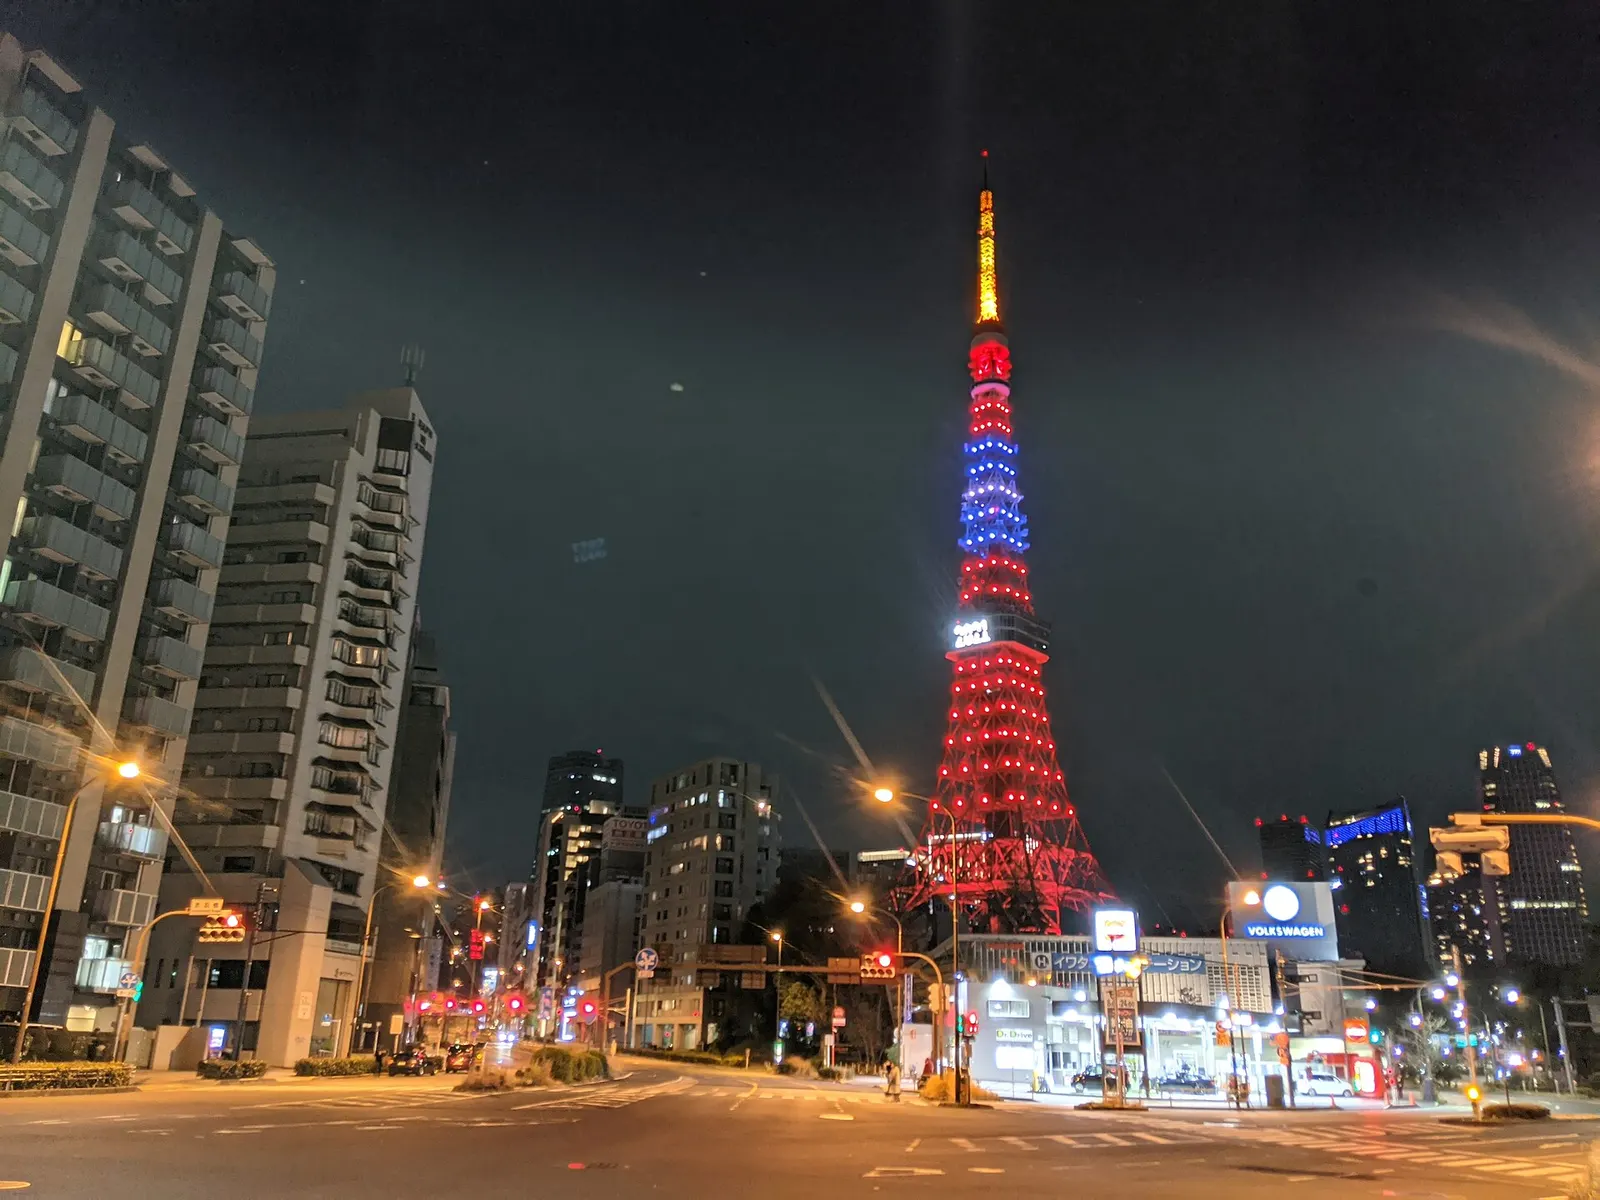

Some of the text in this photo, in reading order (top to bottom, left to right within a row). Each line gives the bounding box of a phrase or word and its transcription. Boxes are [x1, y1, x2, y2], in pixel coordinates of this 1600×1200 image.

[1247, 926, 1324, 937] VOLKSWAGEN
[1054, 956, 1089, 970] イワタ
